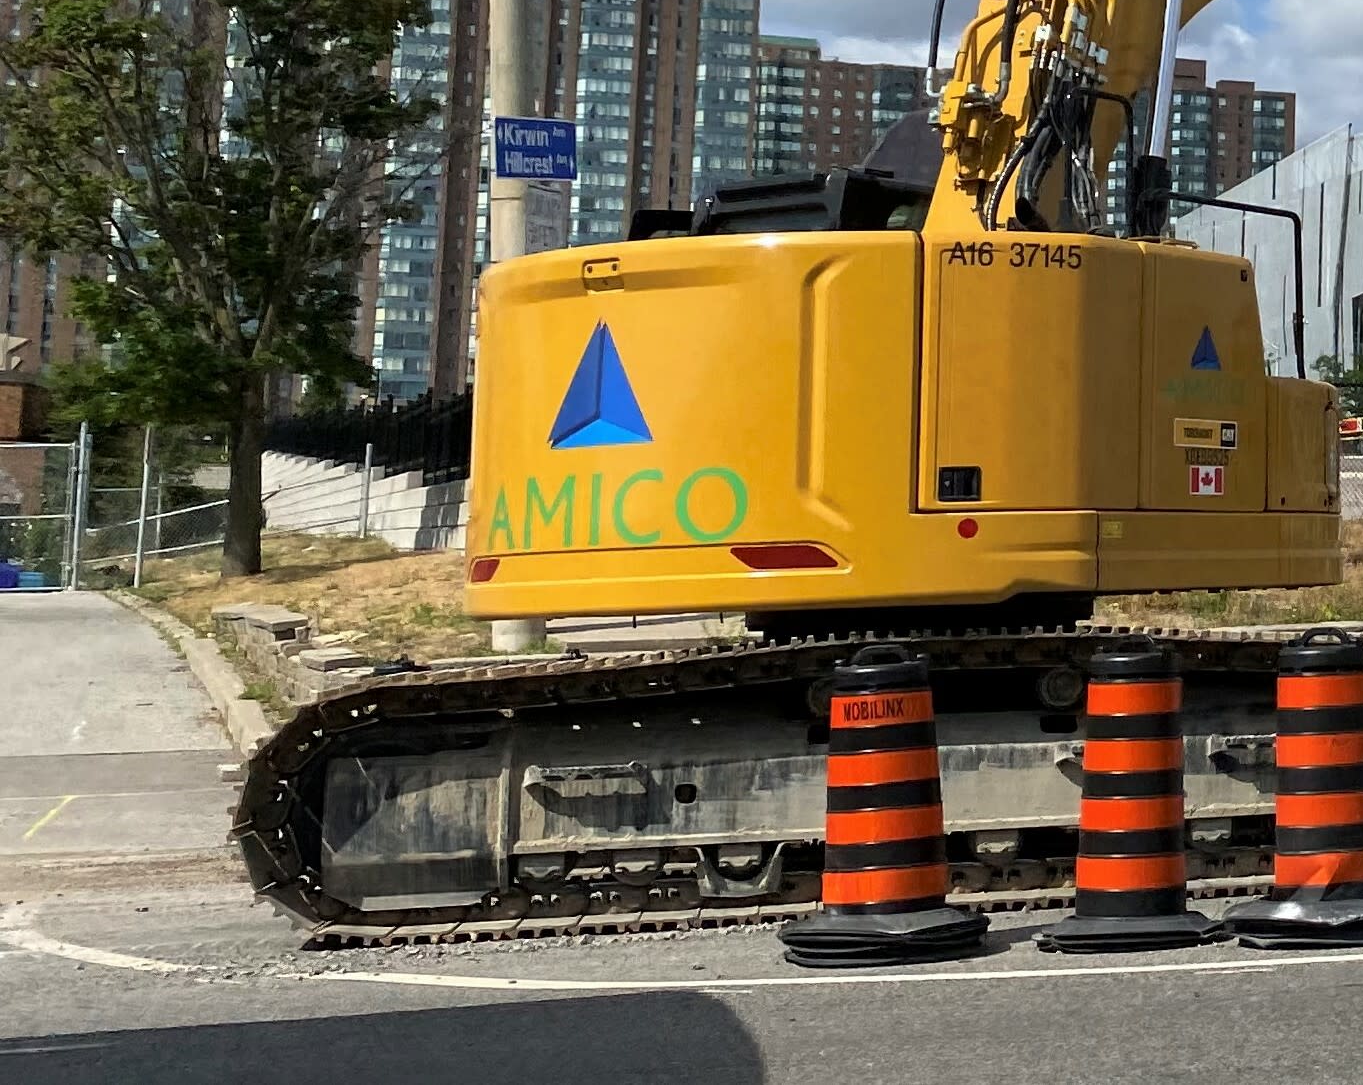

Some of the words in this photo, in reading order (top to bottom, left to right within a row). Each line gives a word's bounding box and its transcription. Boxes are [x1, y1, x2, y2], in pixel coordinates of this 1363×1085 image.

[504, 123, 549, 147] Kirwin
[504, 150, 554, 174] Hillcrest
[948, 242, 995, 267] A16
[1009, 243, 1083, 270] 37145
[488, 466, 749, 551] AMICO
[843, 698, 904, 722] MOBILINX
